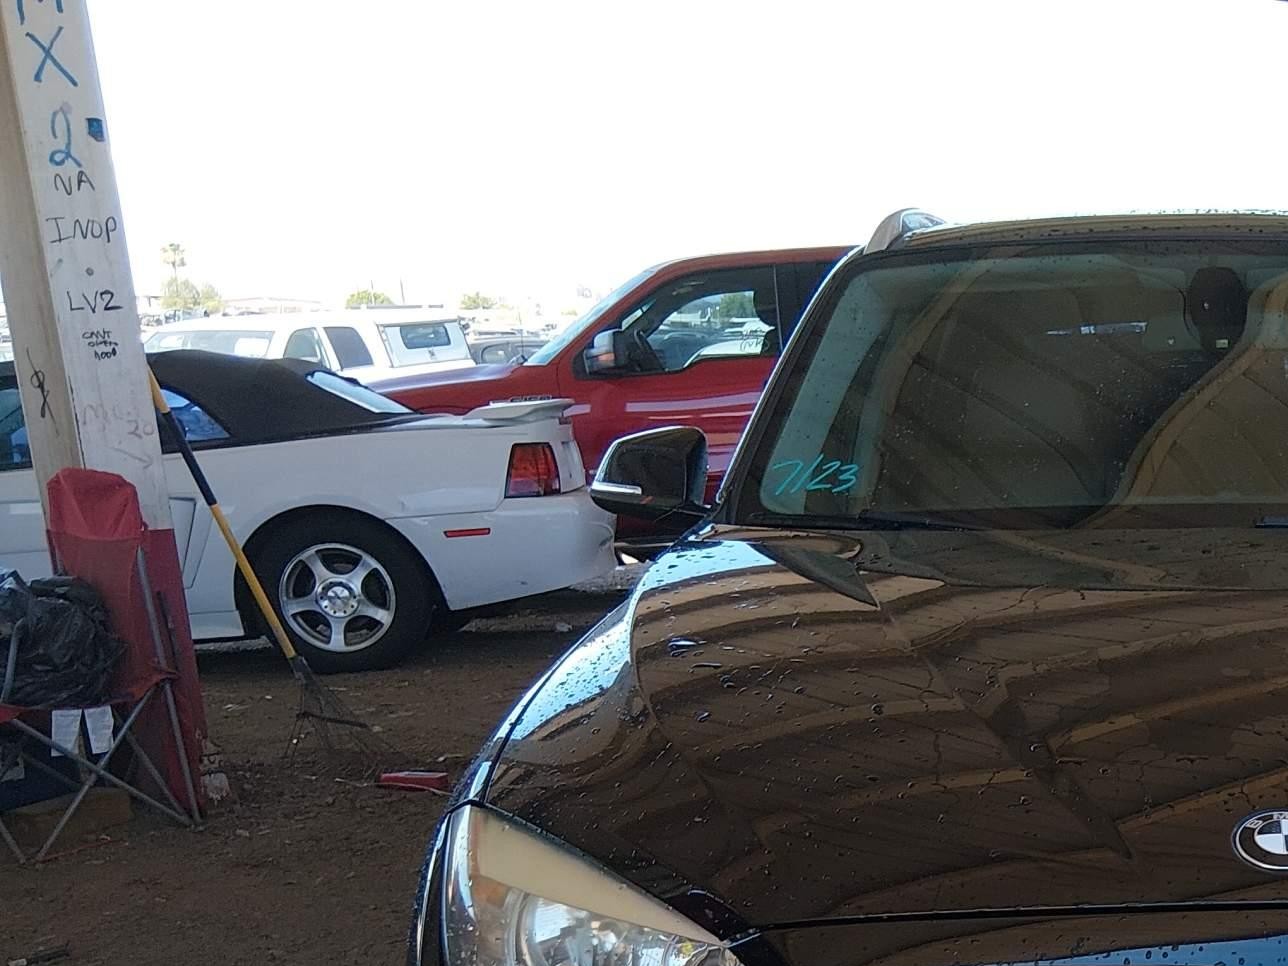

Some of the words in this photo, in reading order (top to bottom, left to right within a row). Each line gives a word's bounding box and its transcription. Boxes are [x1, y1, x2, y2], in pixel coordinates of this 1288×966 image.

[25, 26, 78, 87] X
[49, 109, 82, 168] 2
[54, 170, 95, 196] NA
[46, 216, 117, 243] INOP
[66, 289, 123, 314] LV2
[773, 453, 858, 496] 7/23
